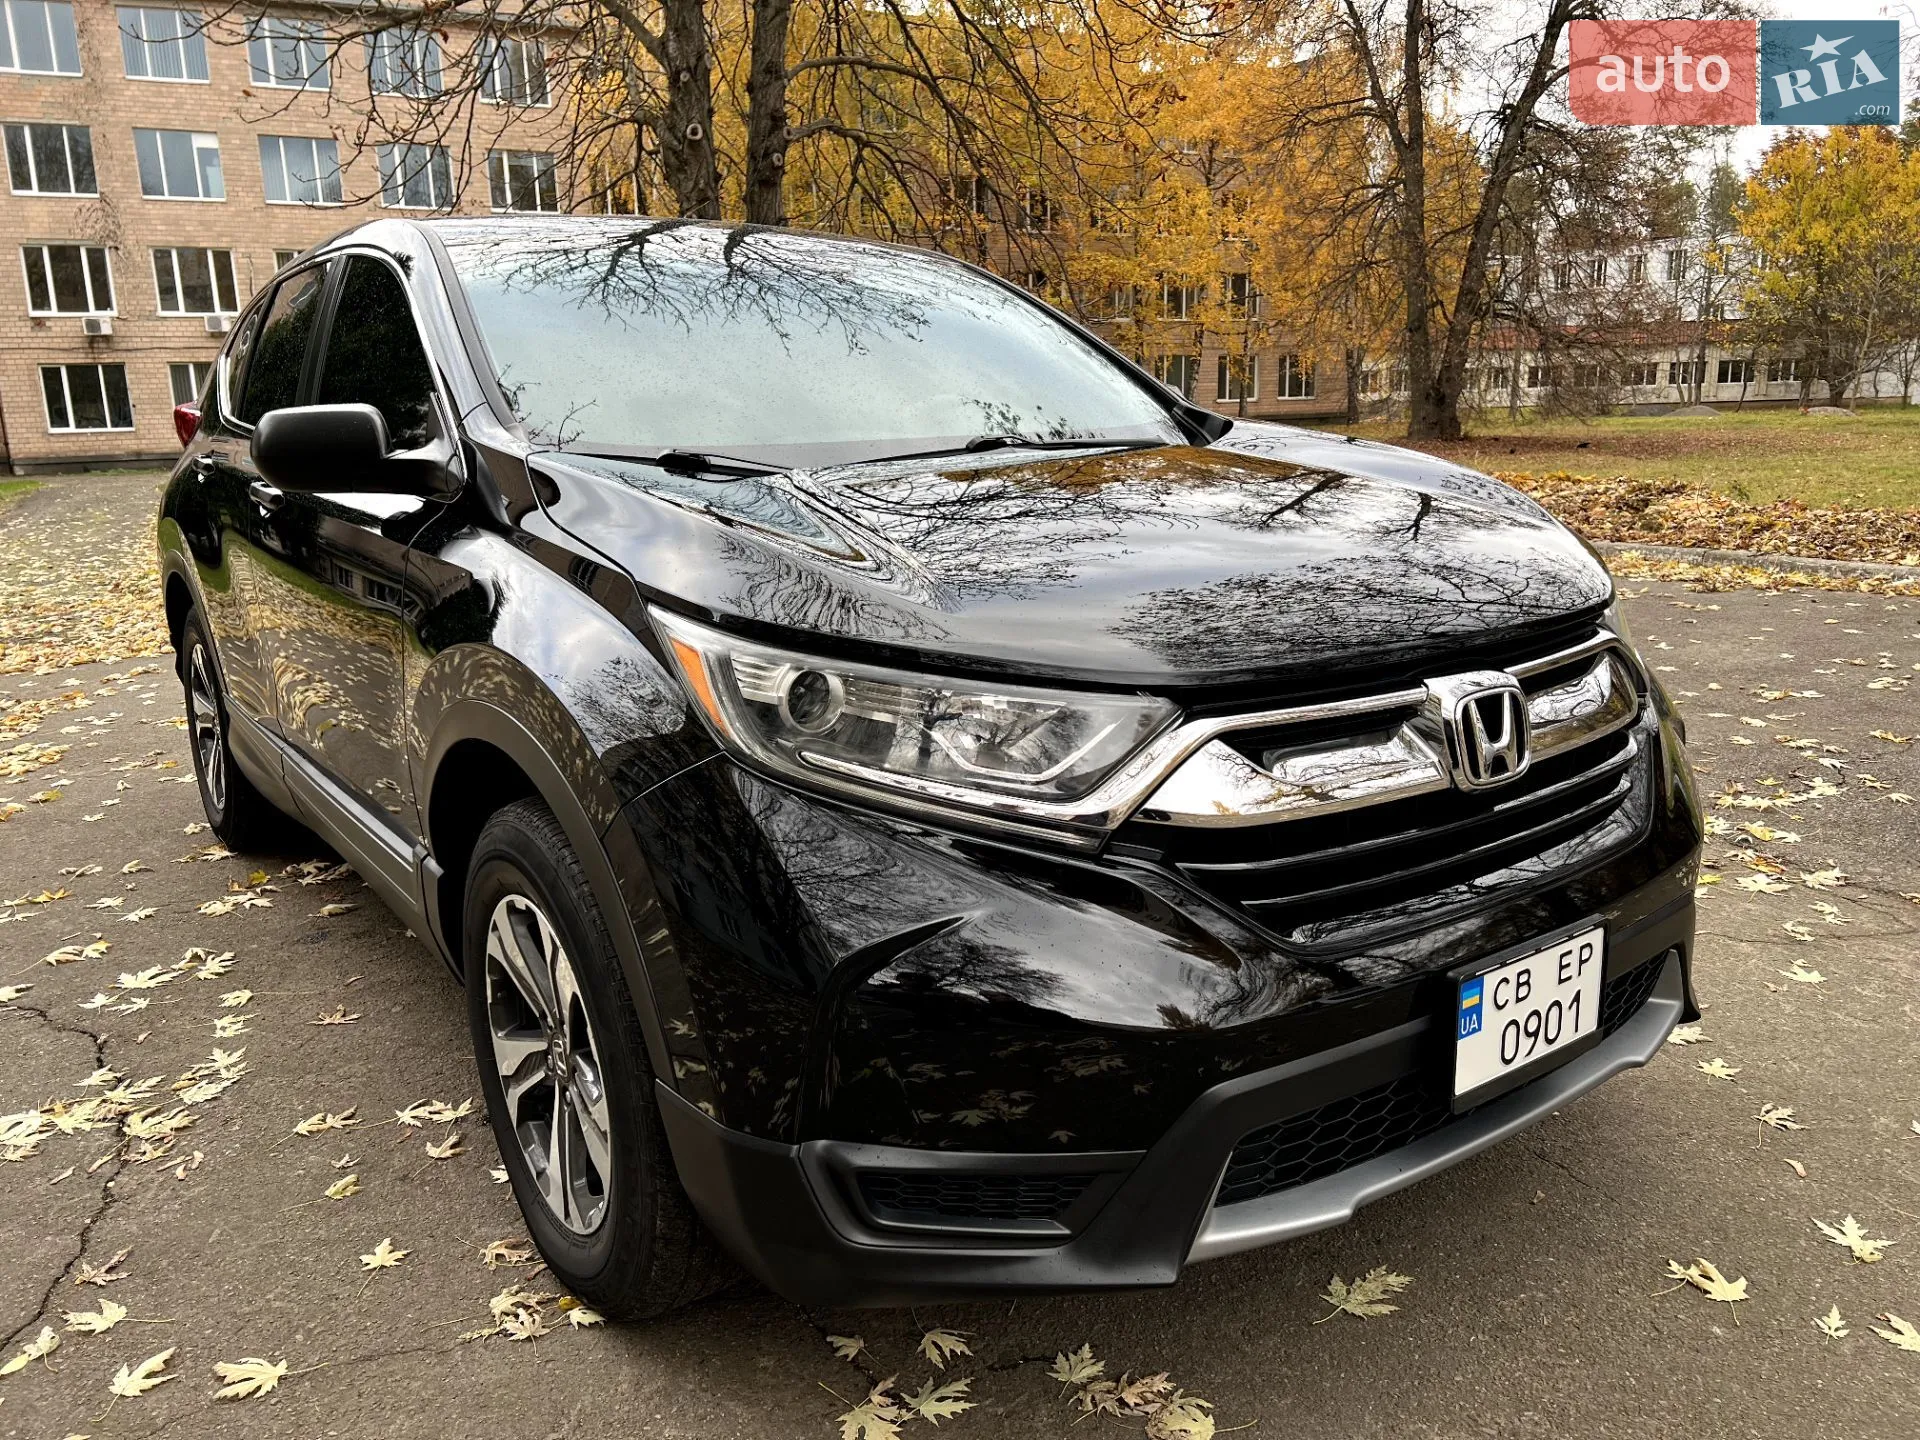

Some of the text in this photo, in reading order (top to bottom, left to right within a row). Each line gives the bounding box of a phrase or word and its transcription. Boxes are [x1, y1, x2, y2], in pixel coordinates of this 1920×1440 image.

[1493, 942, 1594, 1011] CB EP
[1460, 1013, 1479, 1035] UA
[1500, 989, 1582, 1066] 0901
